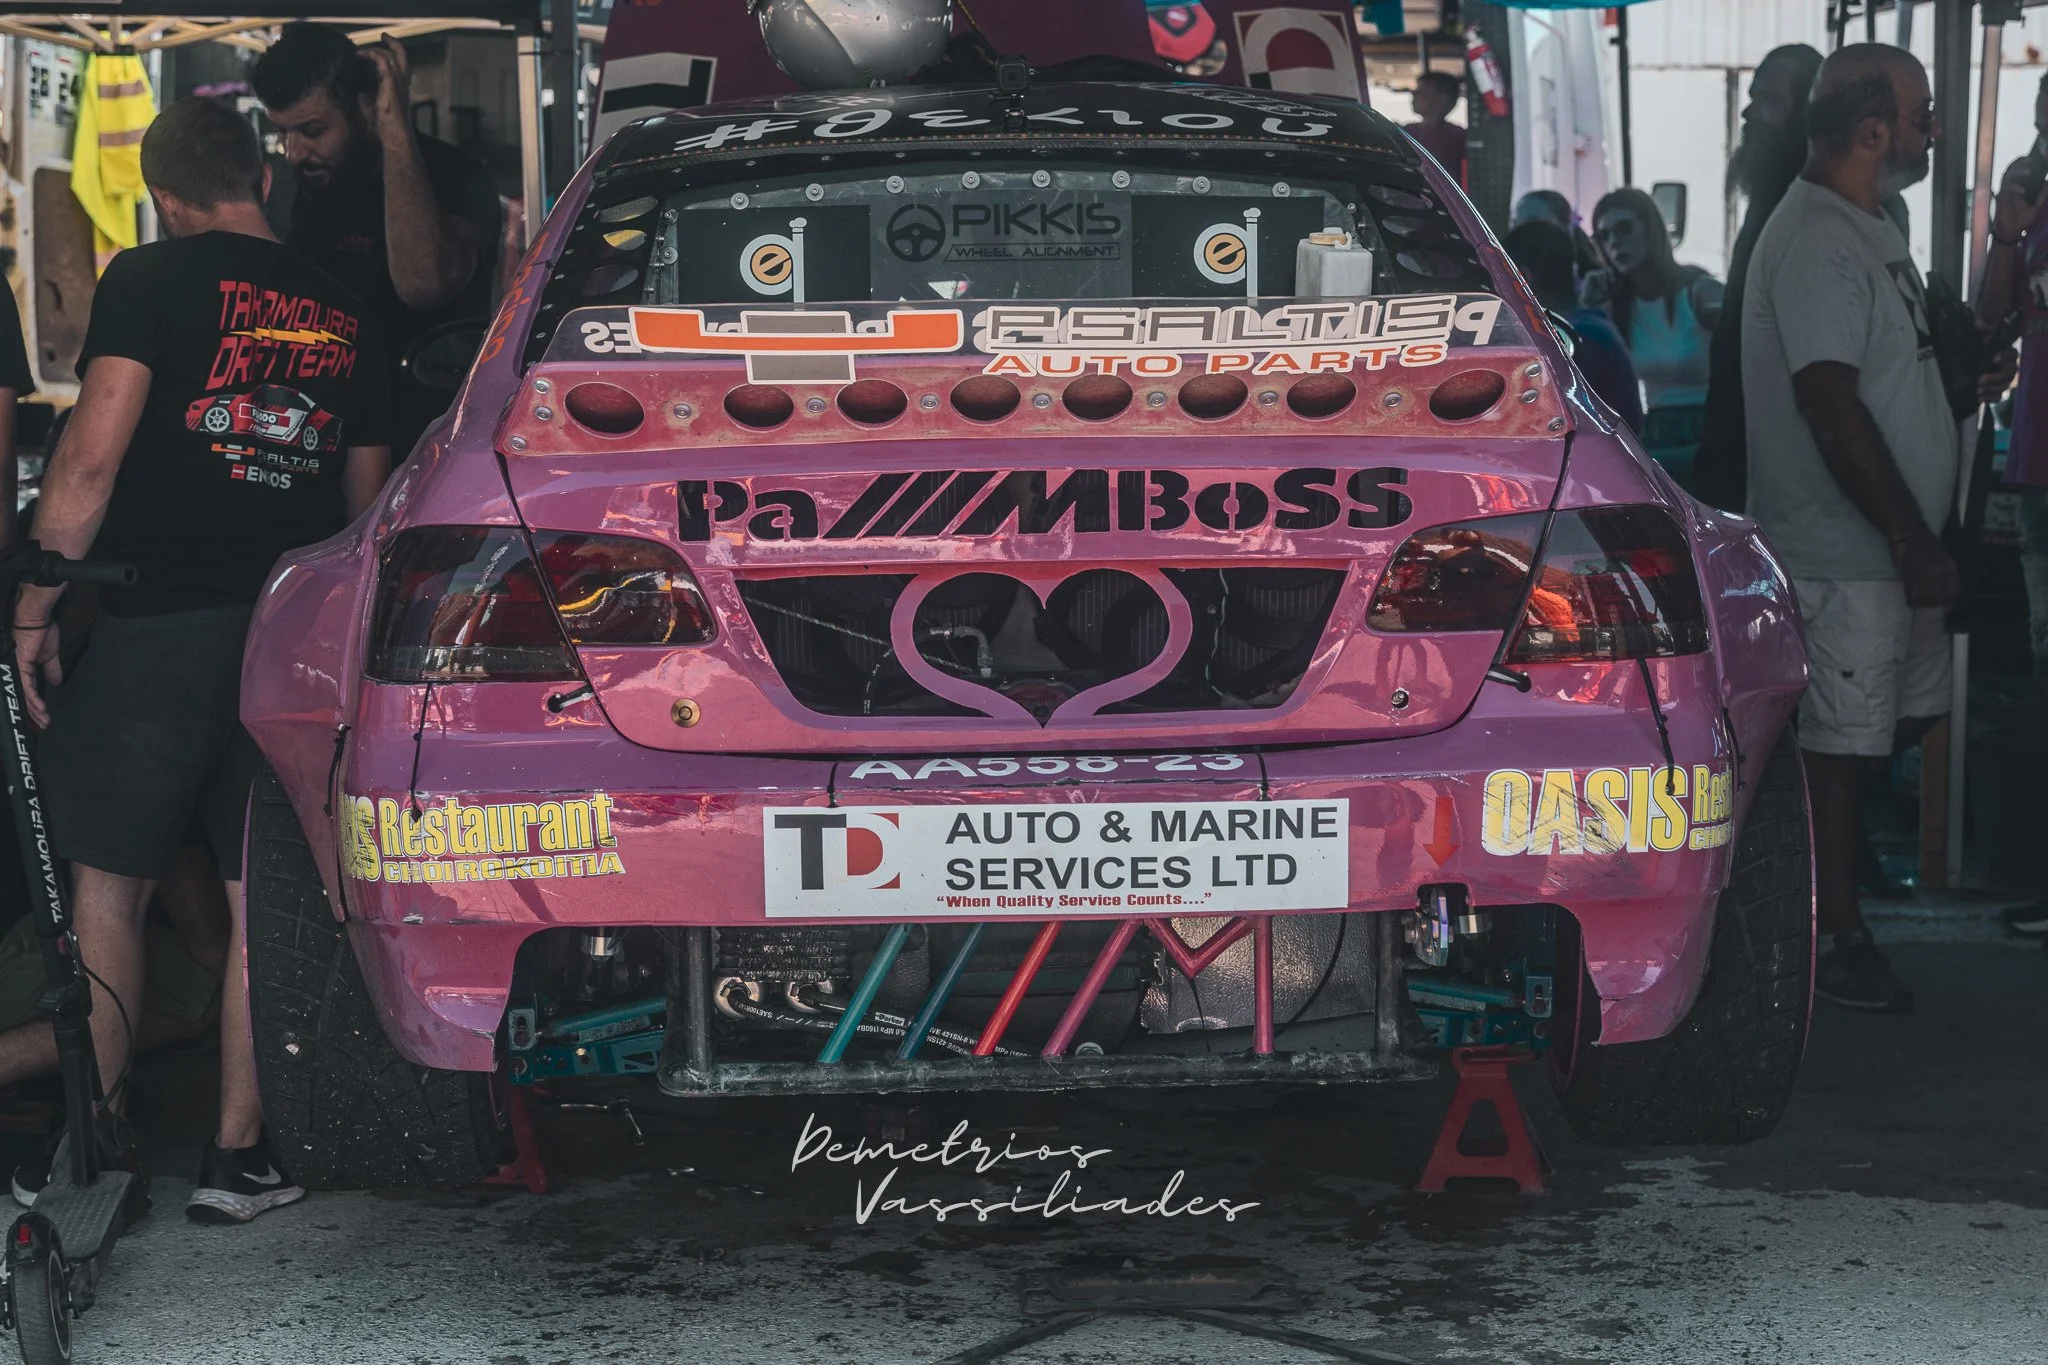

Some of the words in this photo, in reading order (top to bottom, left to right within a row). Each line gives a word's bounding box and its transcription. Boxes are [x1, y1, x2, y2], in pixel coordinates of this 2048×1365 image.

[952, 202, 1122, 236] PIKKIS
[954, 247, 1014, 259] WHEEL
[1022, 246, 1115, 258] ALIGNMENT
[219, 280, 358, 338] TAKAMOURA
[988, 296, 1455, 345] PSALTIS
[205, 335, 281, 391] DRFT
[285, 340, 357, 380] TEAM
[986, 354, 1179, 375] AUTO
[1209, 343, 1444, 375] PARTS
[257, 447, 320, 468] PALTIS
[246, 465, 293, 490] ENOS
[0, 662, 23, 725] TEAM
[14, 728, 38, 791] DRIFT
[850, 754, 1246, 781] AA558-23
[379, 792, 618, 858] Restaurant
[945, 810, 1081, 845] AUTO
[1099, 808, 1132, 845] &
[1150, 806, 1339, 844] MARINE
[1482, 767, 1690, 857] OASIS
[29, 795, 64, 924] TAKAMOURA
[945, 856, 1192, 892] SERVICES
[1211, 852, 1298, 888] LTD
[995, 894, 1053, 909] Quality
[1058, 893, 1122, 907] Service
[855, 1024, 880, 1034] (160BA
[874, 1012, 905, 1026] Parker
[880, 1026, 895, 1036] MPa
